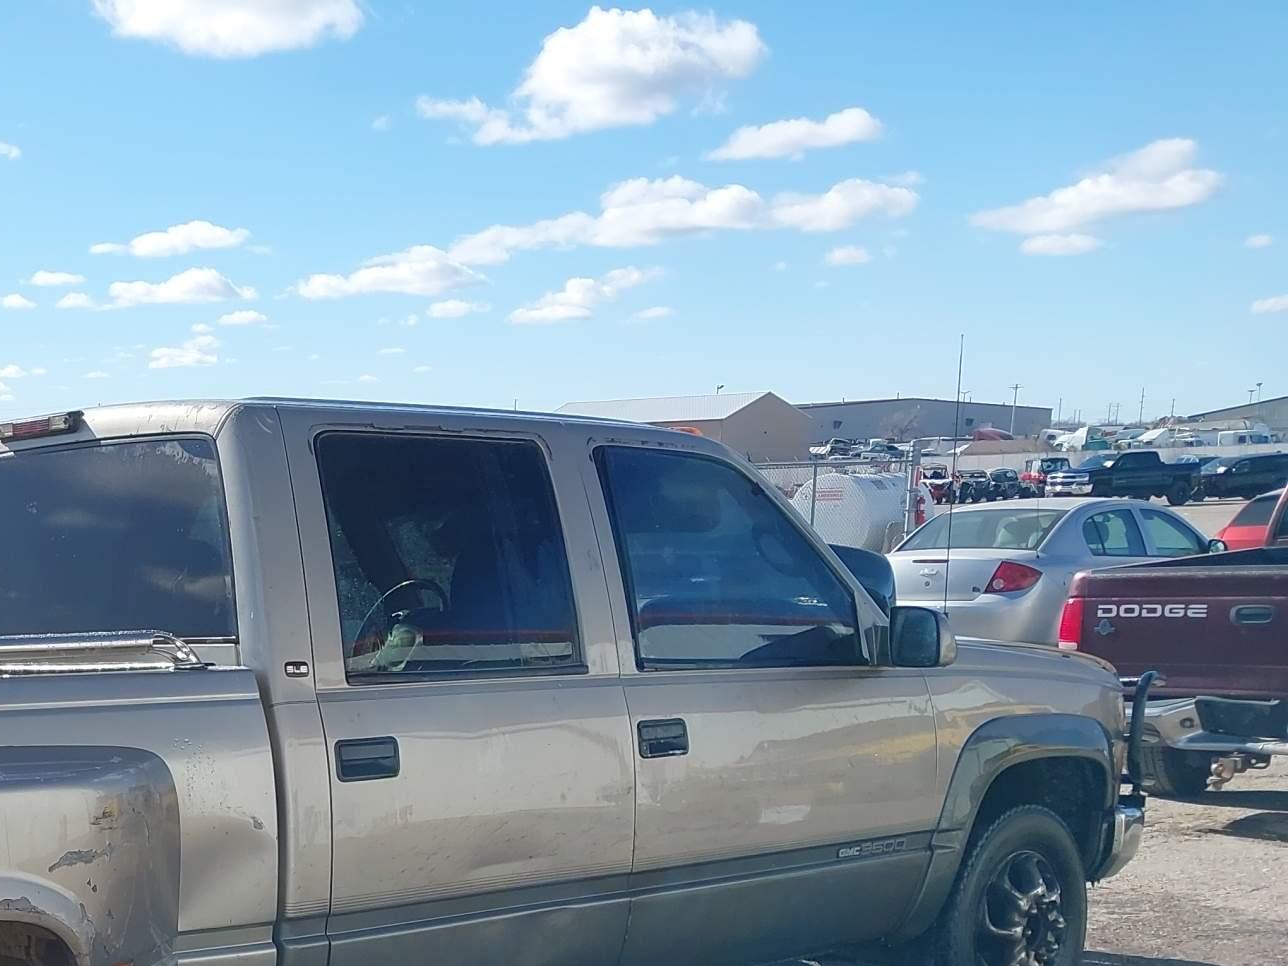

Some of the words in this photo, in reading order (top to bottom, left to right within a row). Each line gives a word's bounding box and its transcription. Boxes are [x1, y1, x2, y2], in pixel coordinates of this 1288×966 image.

[1096, 604, 1208, 618] DODGE
[286, 665, 308, 673] SLE
[838, 846, 861, 858] GMC
